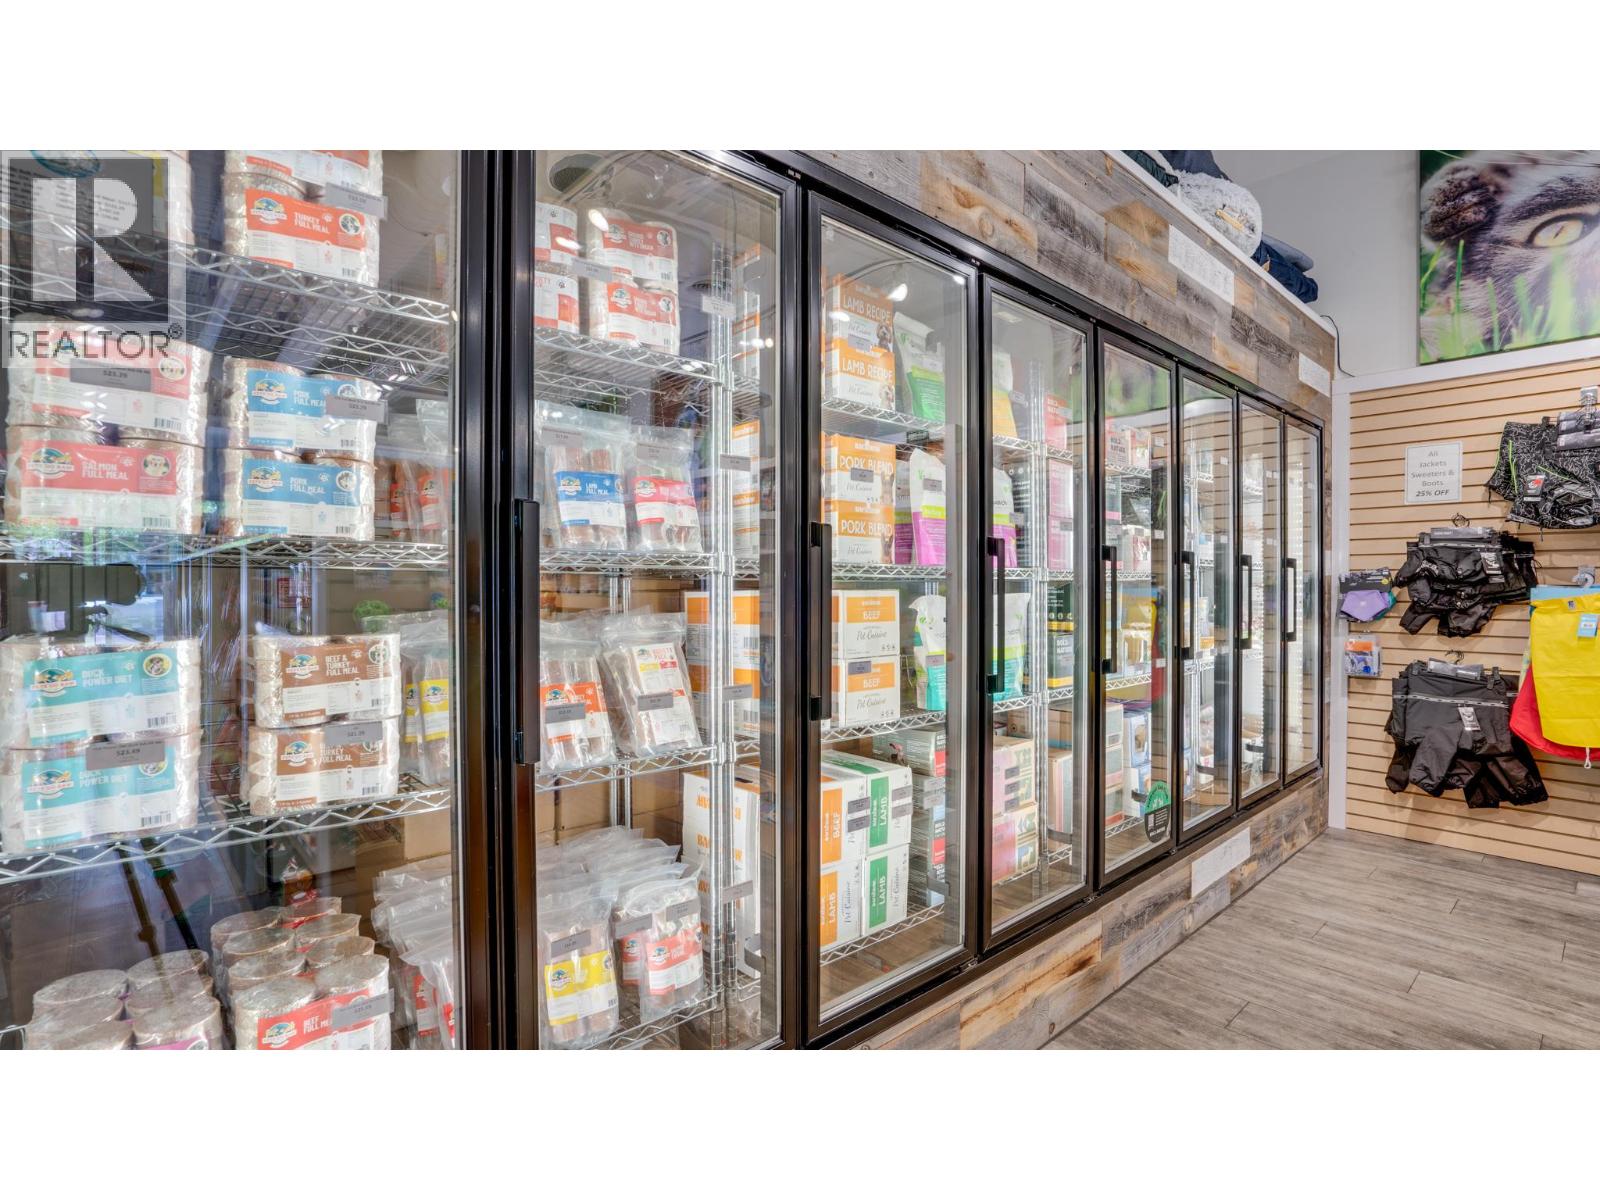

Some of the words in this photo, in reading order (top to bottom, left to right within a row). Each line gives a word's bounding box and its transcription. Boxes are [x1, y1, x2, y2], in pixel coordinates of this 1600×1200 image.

[843, 295, 865, 313] LAMB
[866, 303, 892, 322] RECIPE
[842, 358, 866, 376] LAMB
[867, 364, 893, 380] RECIPE
[82, 462, 118, 472] SALMON
[840, 456, 865, 471] PORK
[867, 459, 893, 475] BLEND
[82, 469, 104, 479] FULL
[105, 471, 129, 480] MEAL
[290, 484, 306, 492] FULL
[841, 520, 865, 534] PORK
[868, 523, 893, 536] BLEND
[863, 611, 880, 619] BEEF
[325, 655, 341, 664] BEEF
[325, 661, 350, 670] TURKEY
[326, 668, 342, 676] FULL
[342, 666, 360, 675] MEAL
[863, 679, 880, 688] BEEF
[320, 747, 344, 757] TURKEY
[336, 753, 352, 762] MEAL
[879, 796, 887, 827] LAMB
[832, 812, 841, 838] BEEF
[879, 875, 887, 905] LAMB
[829, 892, 837, 923] LAMB
[303, 1015, 320, 1026] BEEF
[303, 1023, 321, 1034] FULL
